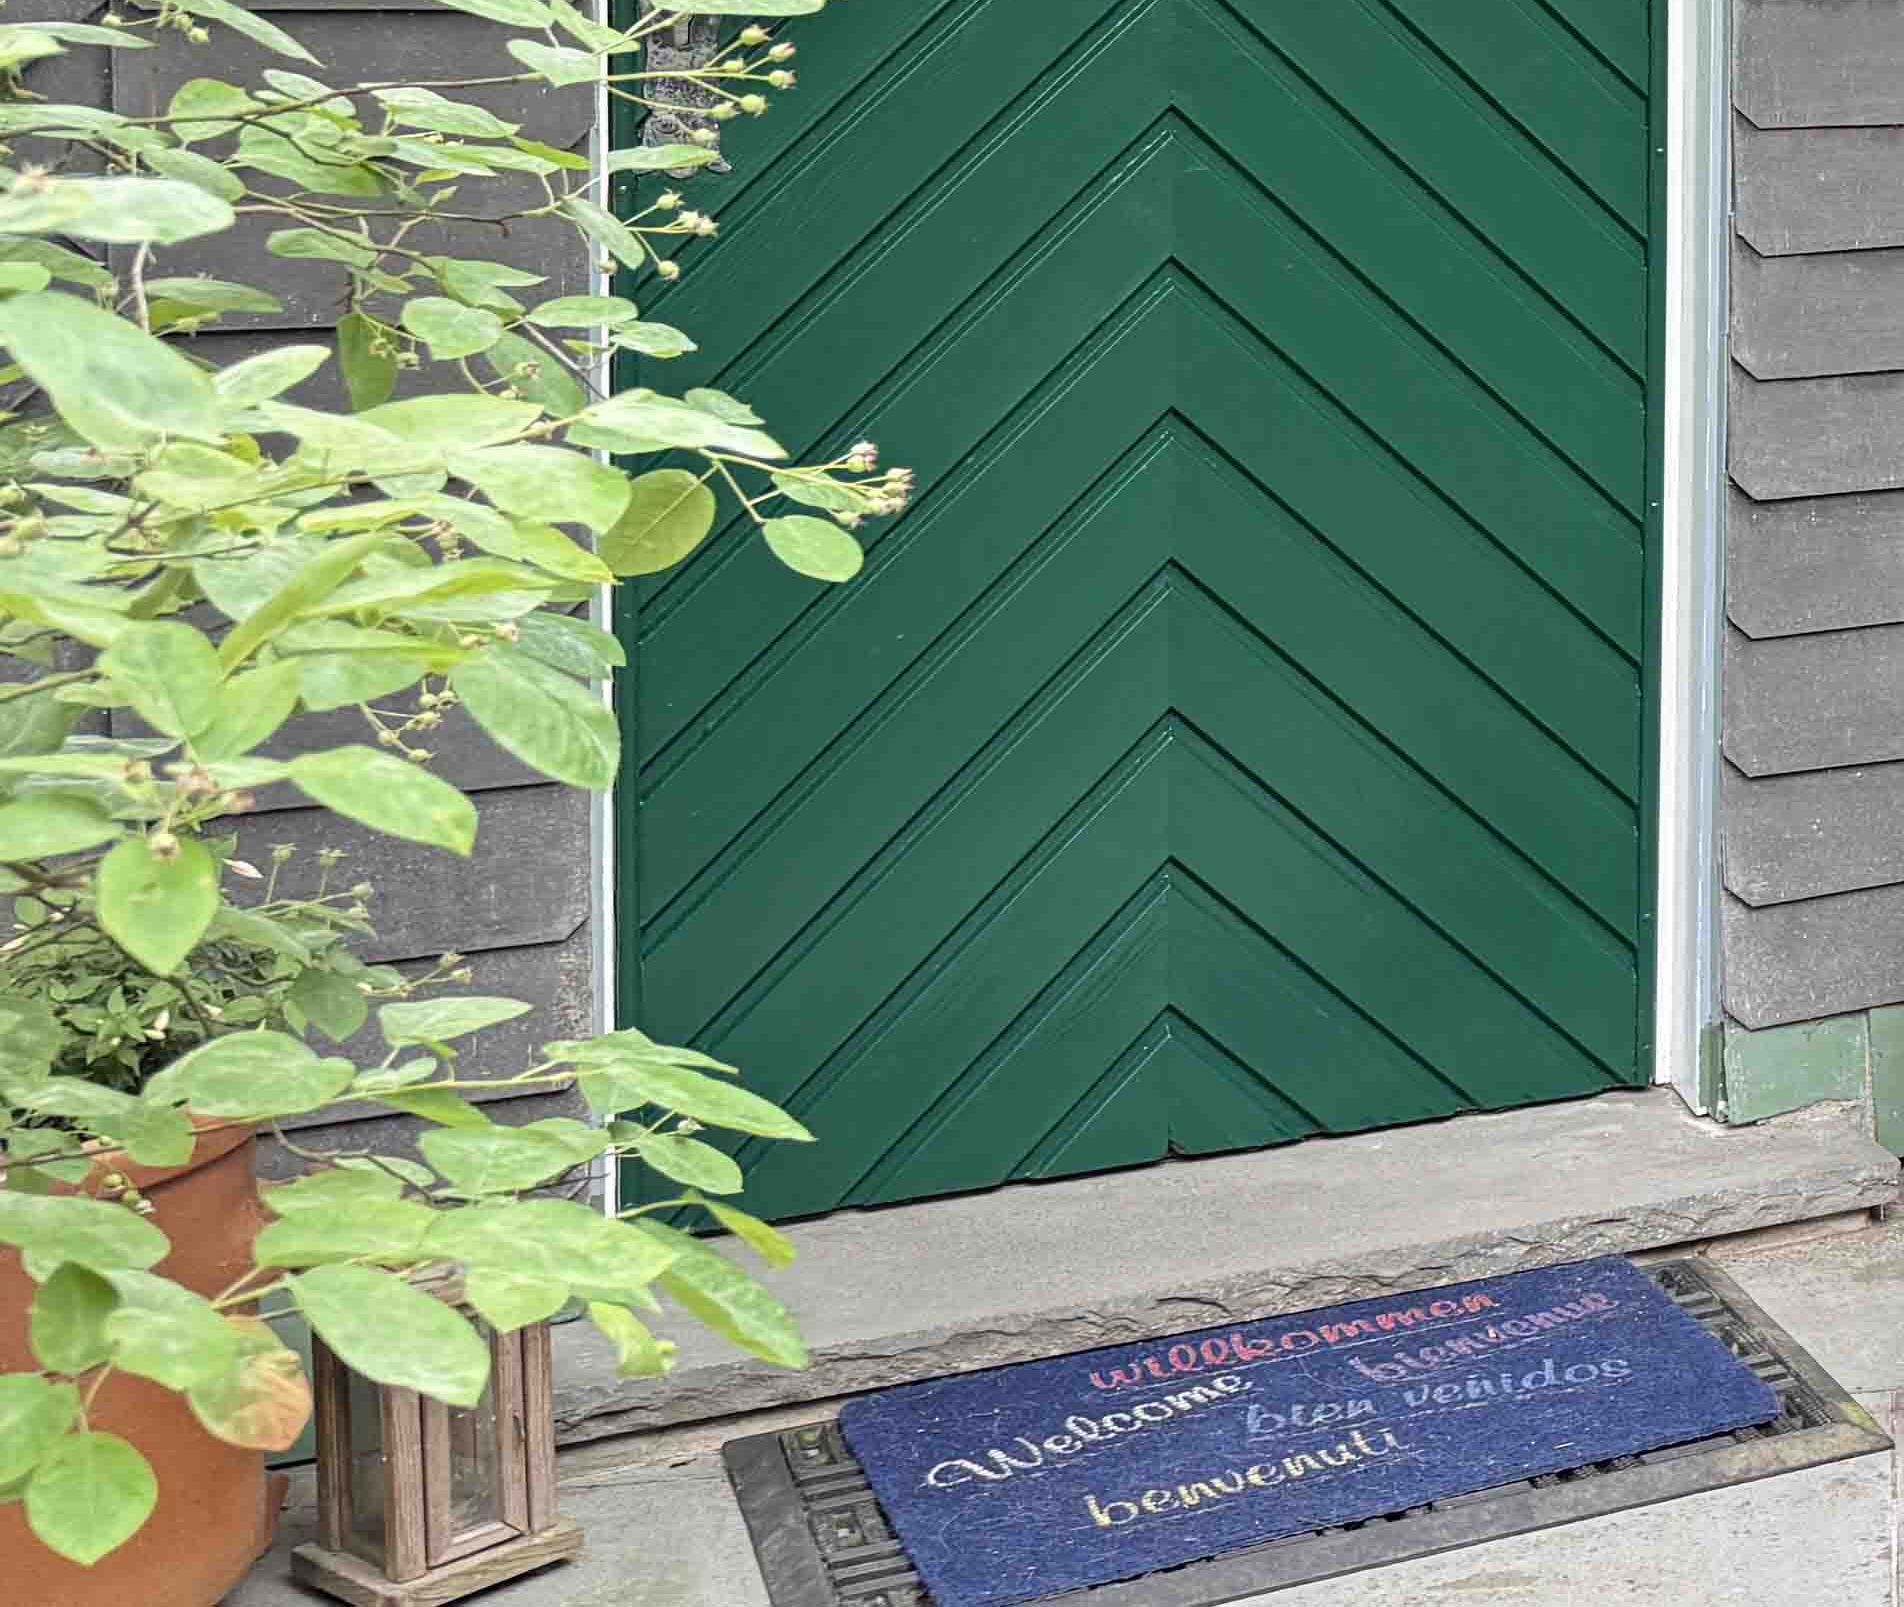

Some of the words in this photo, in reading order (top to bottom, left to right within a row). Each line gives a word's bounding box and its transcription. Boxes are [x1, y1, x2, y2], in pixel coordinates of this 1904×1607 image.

[1089, 1293, 1499, 1390] willkommen
[923, 1374, 1254, 1488] Welcome
[1246, 1397, 1377, 1436] bien
[1086, 1428, 1410, 1528] benvenuti
